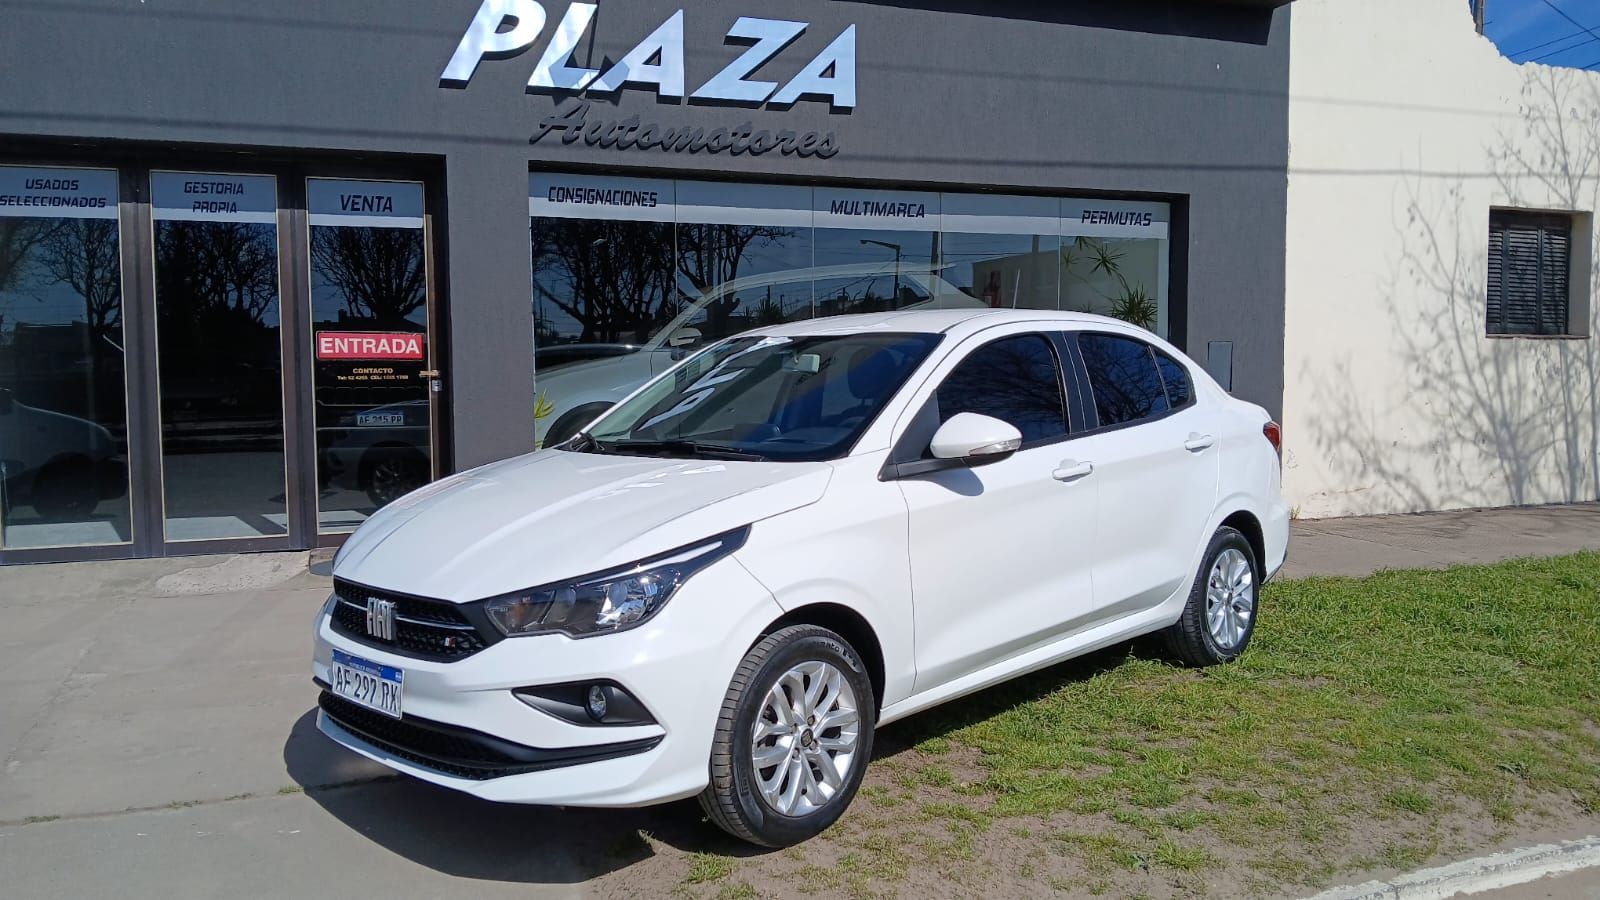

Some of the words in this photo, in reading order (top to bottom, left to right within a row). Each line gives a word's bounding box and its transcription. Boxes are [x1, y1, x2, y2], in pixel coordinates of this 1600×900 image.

[438, 0, 856, 112] PLAZA
[529, 102, 841, 159] Automotores
[25, 178, 80, 191] USADOS
[184, 181, 245, 195] GESTORIA
[0, 195, 107, 208] SELECCIONADOS
[340, 194, 394, 214] VENTA
[548, 186, 659, 208] CONSIGNACIONES
[192, 201, 238, 214] PROPIA
[830, 200, 926, 219] MULTIMARCA
[1081, 210, 1153, 227] PERMUTAS
[319, 337, 421, 354] ENTRADA
[352, 367, 394, 375] CONTACTO
[367, 597, 395, 641] FIAT
[336, 666, 350, 693] AF
[354, 672, 377, 703] 297
[381, 681, 398, 712] RX
